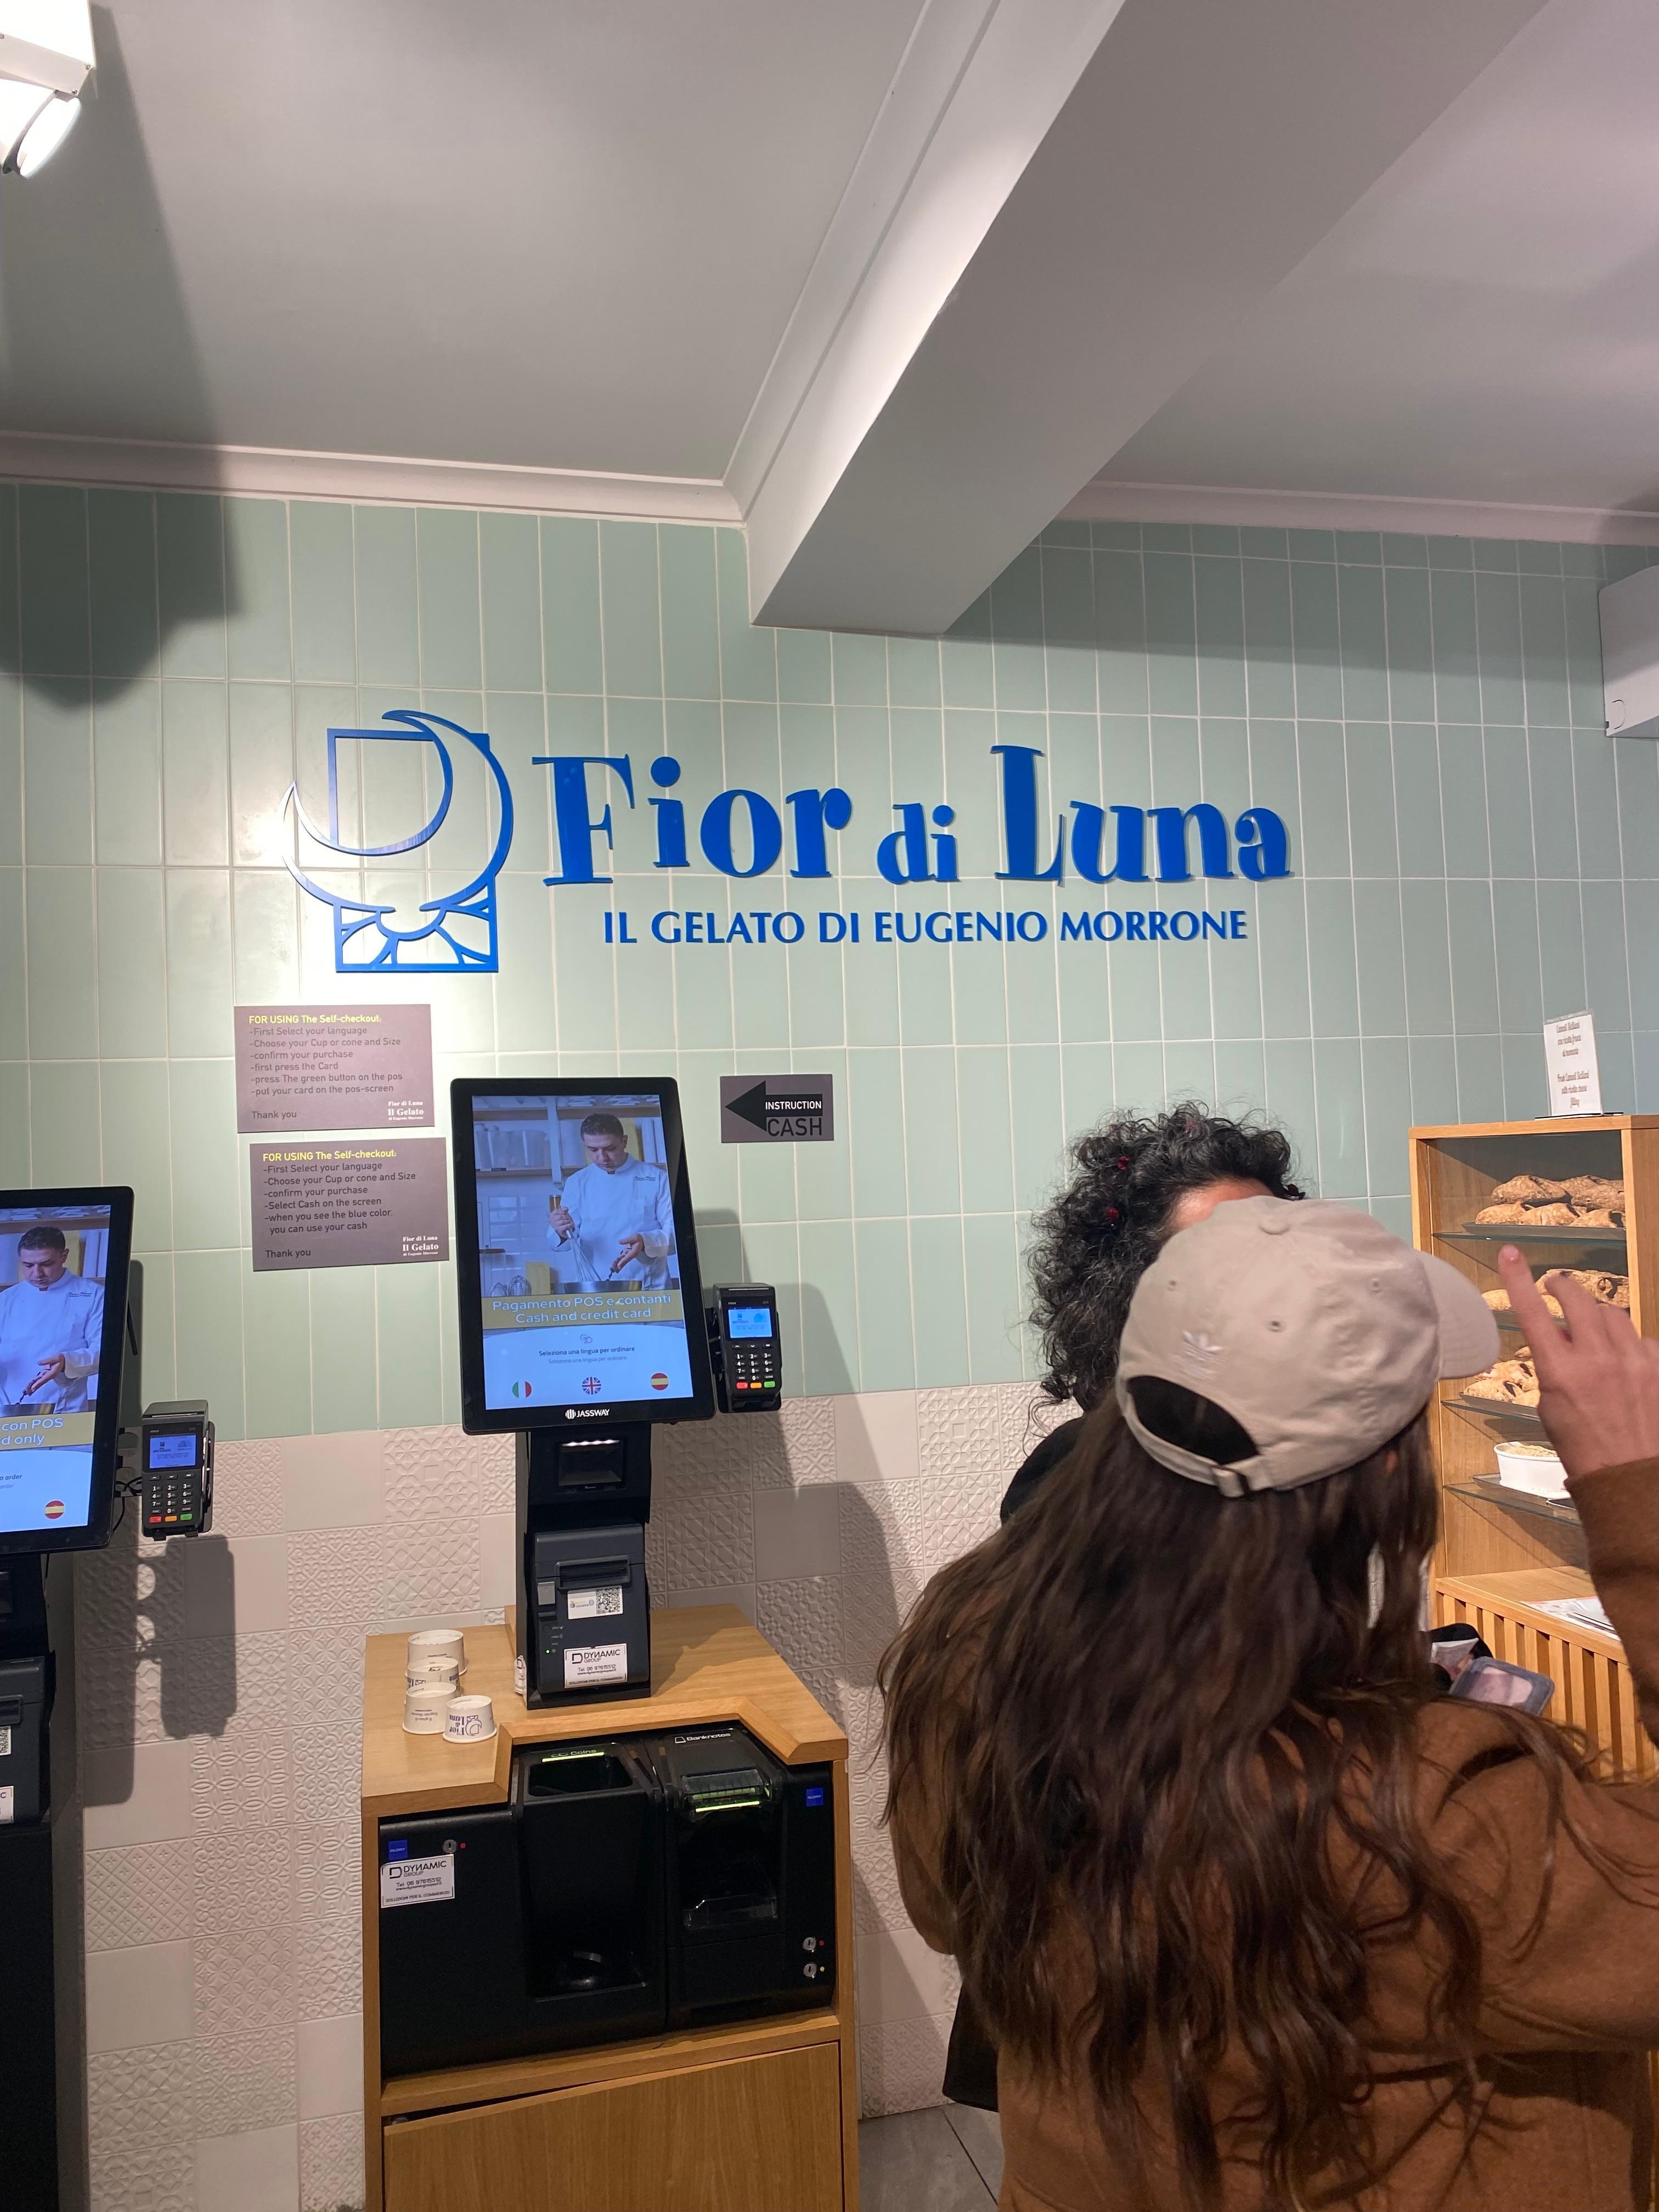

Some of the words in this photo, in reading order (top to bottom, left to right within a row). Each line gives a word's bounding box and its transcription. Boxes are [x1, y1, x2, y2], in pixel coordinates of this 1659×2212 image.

[532, 754, 853, 887] Fior
[877, 803, 961, 885] di
[992, 745, 1293, 887] Luna
[604, 912, 636, 944] IL
[652, 910, 805, 944] GELATO
[819, 912, 860, 944] DI
[877, 910, 1048, 944] EUGENIO
[1060, 909, 1249, 942] MORRONE
[306, 1028, 325, 1036] your
[328, 1027, 367, 1036] language
[311, 1039, 328, 1048] Cup
[250, 1051, 288, 1059] -confirm
[313, 1051, 353, 1059] purchase
[275, 1064, 299, 1072] press
[251, 1076, 280, 1084] -press
[301, 1075, 325, 1084] green
[272, 1087, 292, 1096] your
[345, 1085, 393, 1094] pos-screen
[765, 1101, 821, 1110] INSTRUCTION
[281, 1111, 297, 1120] you
[768, 1118, 822, 1136] CASH
[334, 1150, 397, 1159] Self-checkout:
[320, 1165, 339, 1173] your
[342, 1162, 382, 1171] language
[303, 1177, 323, 1186] your
[325, 1175, 342, 1184] Cup
[305, 1189, 325, 1198] your
[328, 1187, 368, 1197] purchase
[264, 1201, 296, 1210] -Select
[296, 1214, 311, 1222] you
[325, 1224, 345, 1233] your
[296, 1250, 311, 1258] you
[493, 1299, 571, 1312] Pagamento
[574, 1297, 603, 1307] POS
[617, 1294, 671, 1305] contanti
[516, 1312, 549, 1323] Cash
[552, 1311, 577, 1322] and
[580, 1310, 619, 1320] credit
[623, 1308, 651, 1318] card
[2, 1422, 27, 1431] con
[32, 1418, 63, 1429] POS
[15, 1434, 44, 1445] only
[584, 1650, 620, 1658] DYNAMIC
[449, 1715, 464, 1725] Luna
[449, 1727, 464, 1735] Fior
[687, 1733, 731, 1741] Banknotes
[404, 1861, 447, 1872] DYNAMIC
